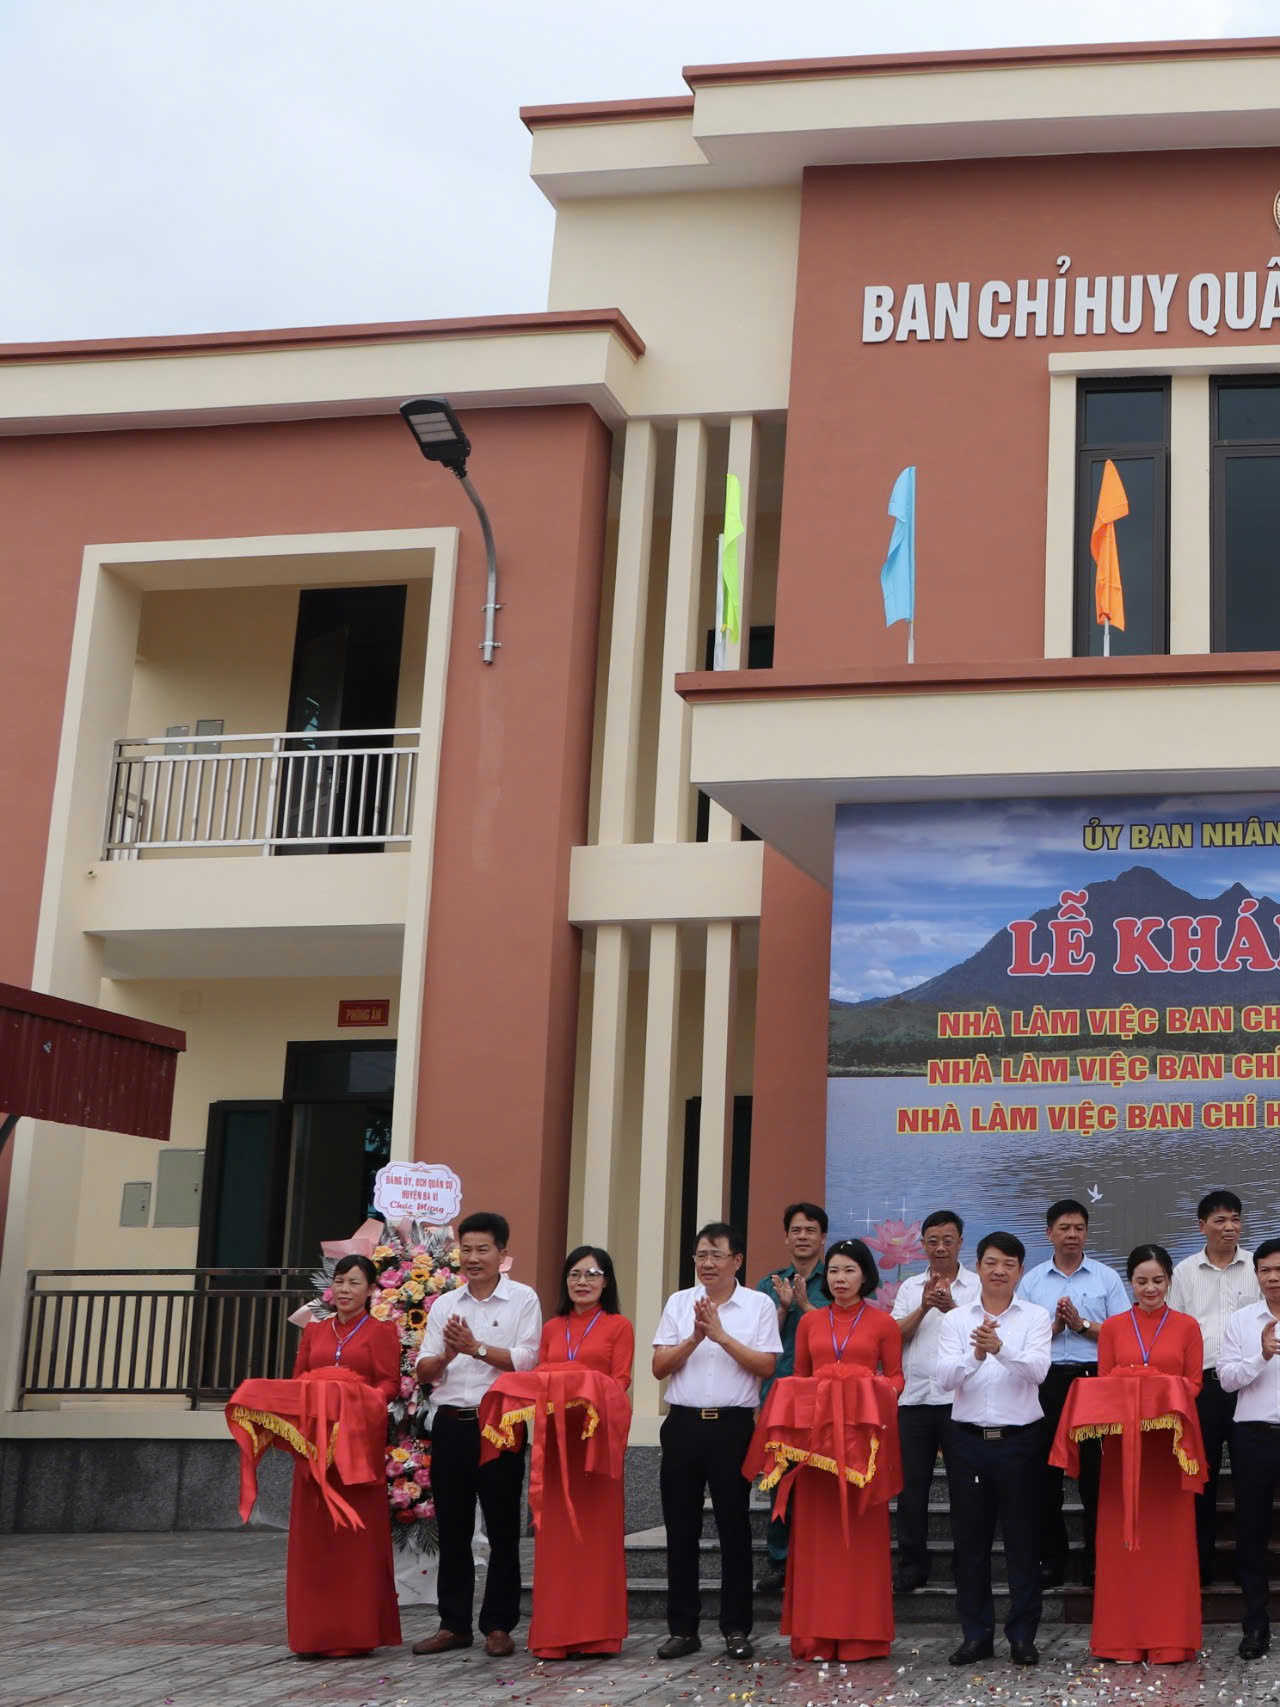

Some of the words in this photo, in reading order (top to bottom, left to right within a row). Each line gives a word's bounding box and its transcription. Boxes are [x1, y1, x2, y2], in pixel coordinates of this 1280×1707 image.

[862, 282, 970, 343] BAN
[978, 255, 1072, 339] CHỈ
[1074, 274, 1178, 336] HUY
[1083, 817, 1124, 851] ỦY
[1130, 823, 1193, 849] BAN
[1006, 889, 1096, 977] LỄ
[937, 1005, 1004, 1039] NHÀ
[1010, 1005, 1079, 1037] LÀM
[1087, 1004, 1159, 1040] VIỆC
[1166, 1006, 1234, 1034] BAN
[927, 1053, 993, 1086] NHÀ
[1001, 1053, 1070, 1084] LÀM
[1077, 1051, 1149, 1087] VIỆC
[1157, 1054, 1224, 1081] BAN
[896, 1102, 963, 1134] NHÀ
[970, 1102, 1039, 1133] LÀM
[1047, 1101, 1119, 1136] VIỆC
[1126, 1104, 1193, 1131] BAN
[1202, 1094, 1258, 1130] CHỈ
[402, 1190, 423, 1201] HUYỆN
[423, 1191, 431, 1201] BA
[415, 1177, 427, 1188] BCH
[428, 1177, 444, 1190] QUÂN
